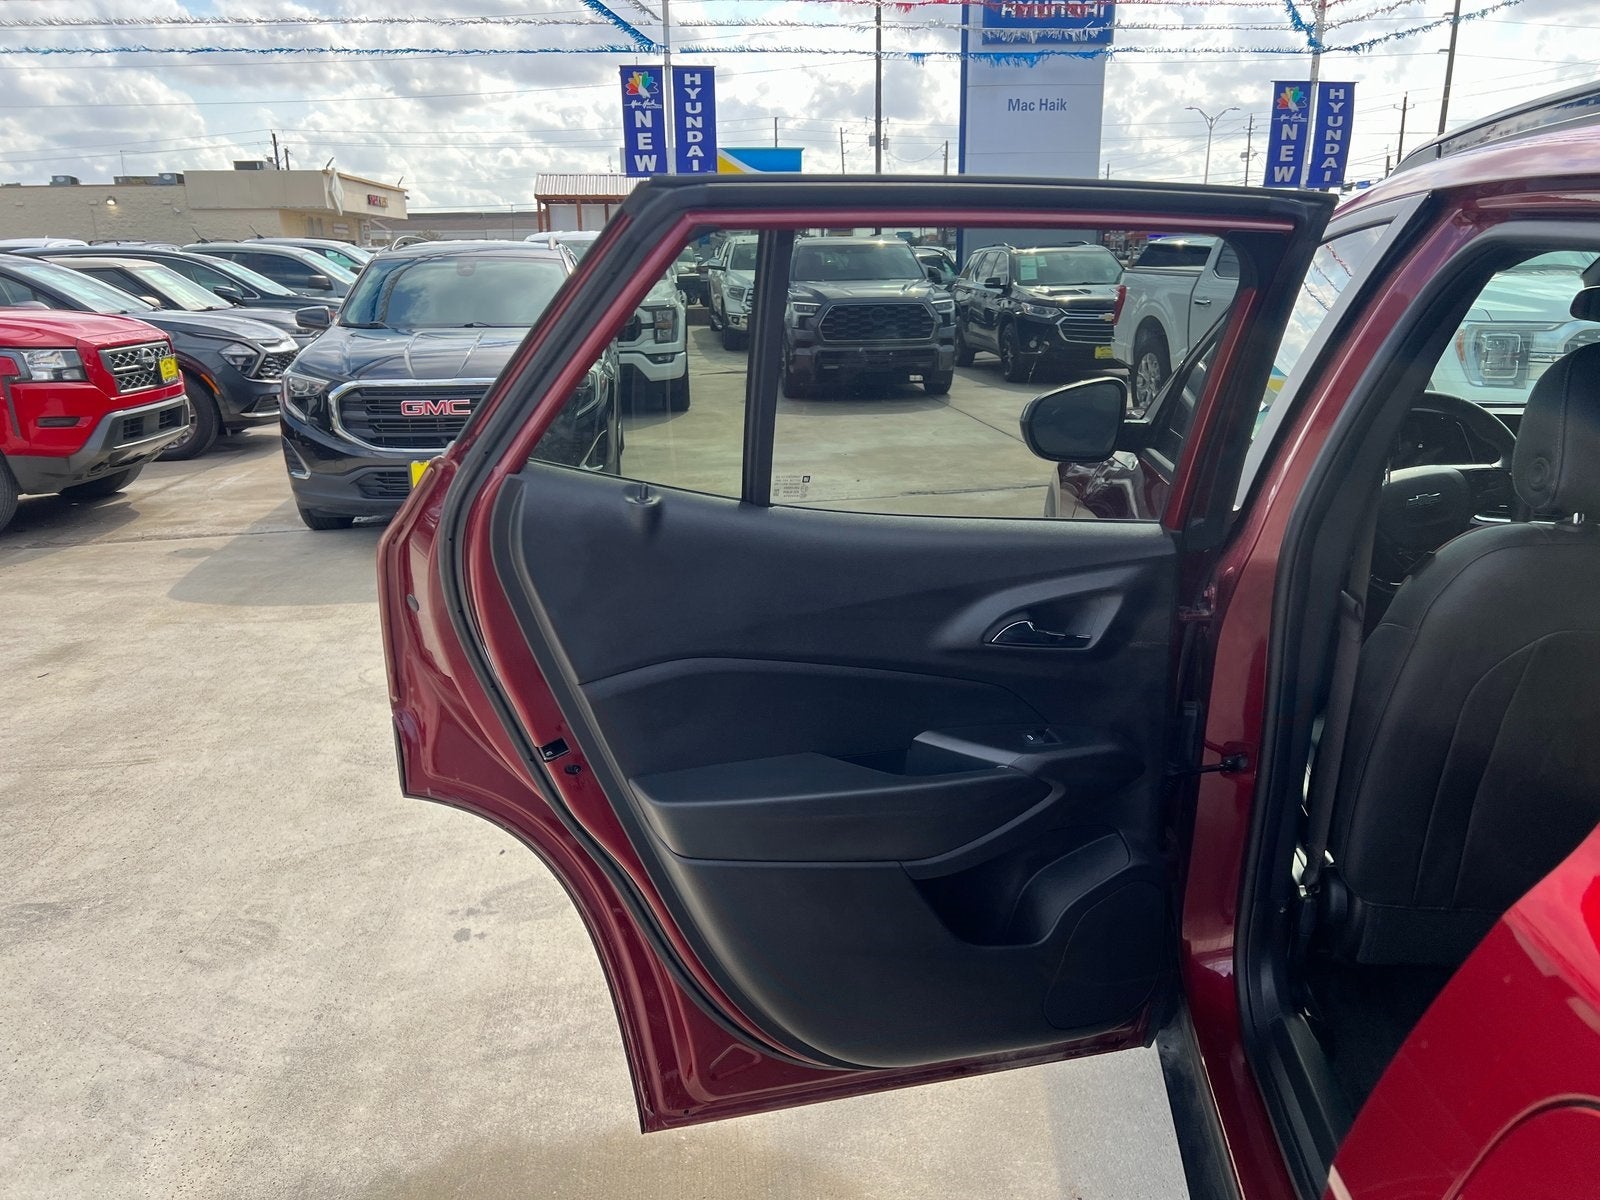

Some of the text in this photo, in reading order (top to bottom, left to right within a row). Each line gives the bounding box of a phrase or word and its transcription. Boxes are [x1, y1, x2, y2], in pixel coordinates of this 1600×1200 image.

[684, 73, 704, 171] HYUNDAI
[1007, 98, 1068, 112] Mac Haik
[1321, 88, 1344, 182] HYUNDAI
[634, 110, 657, 172] NEW
[1273, 123, 1298, 183] NEW
[400, 399, 471, 416] GMC
